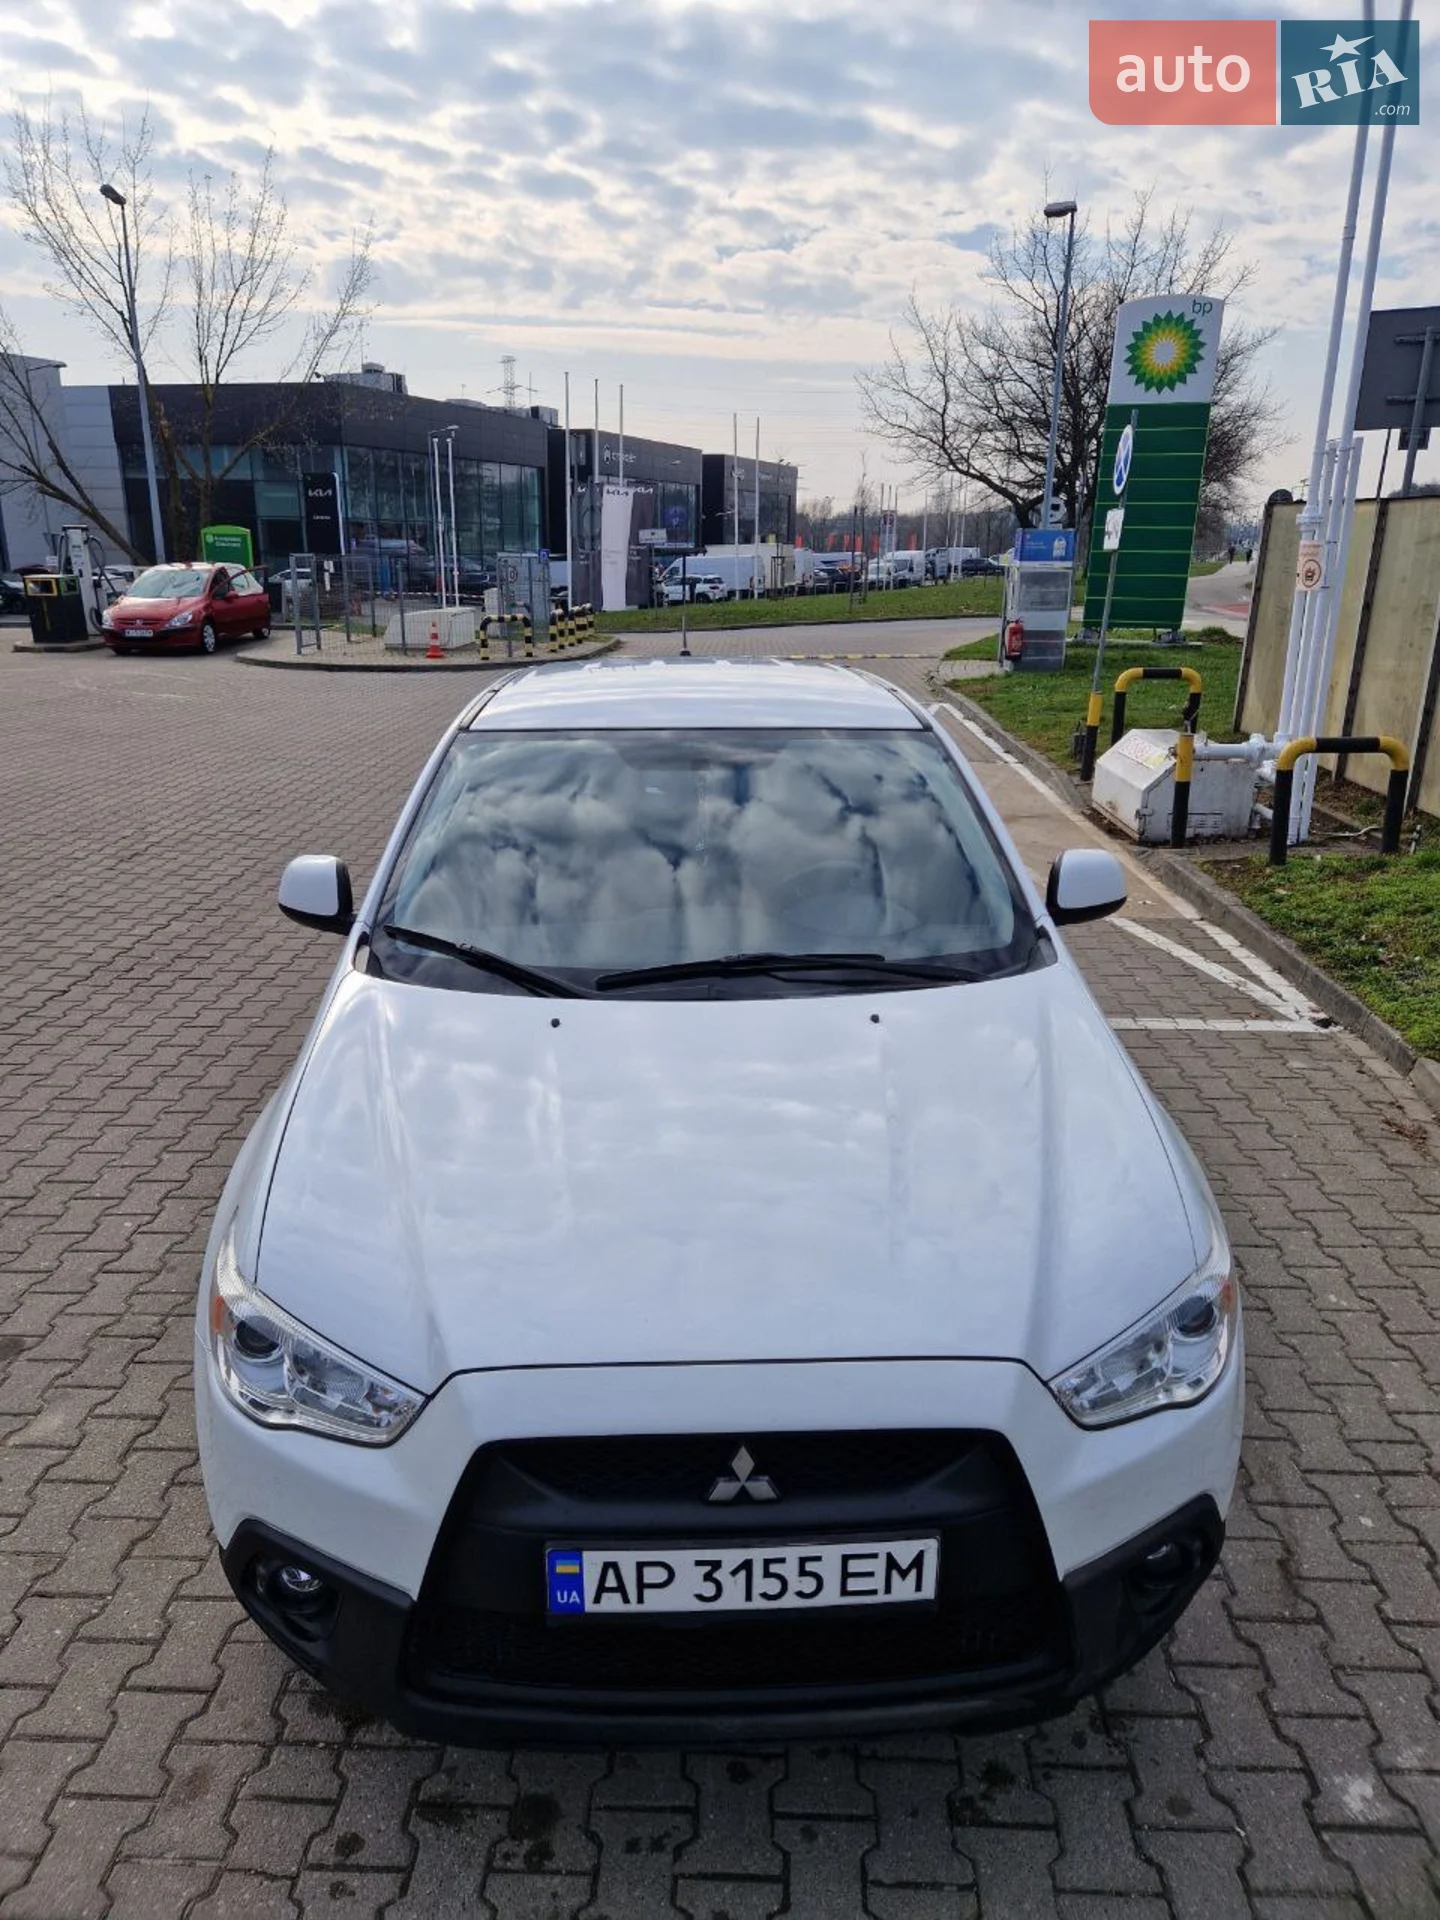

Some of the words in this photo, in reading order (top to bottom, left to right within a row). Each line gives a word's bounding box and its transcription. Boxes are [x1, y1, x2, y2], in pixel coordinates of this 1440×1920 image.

[1192, 299, 1213, 317] bp
[592, 1561, 676, 1606] AP
[693, 1555, 825, 1604] 3155
[838, 1548, 927, 1598] EM
[556, 1590, 580, 1605] UA
